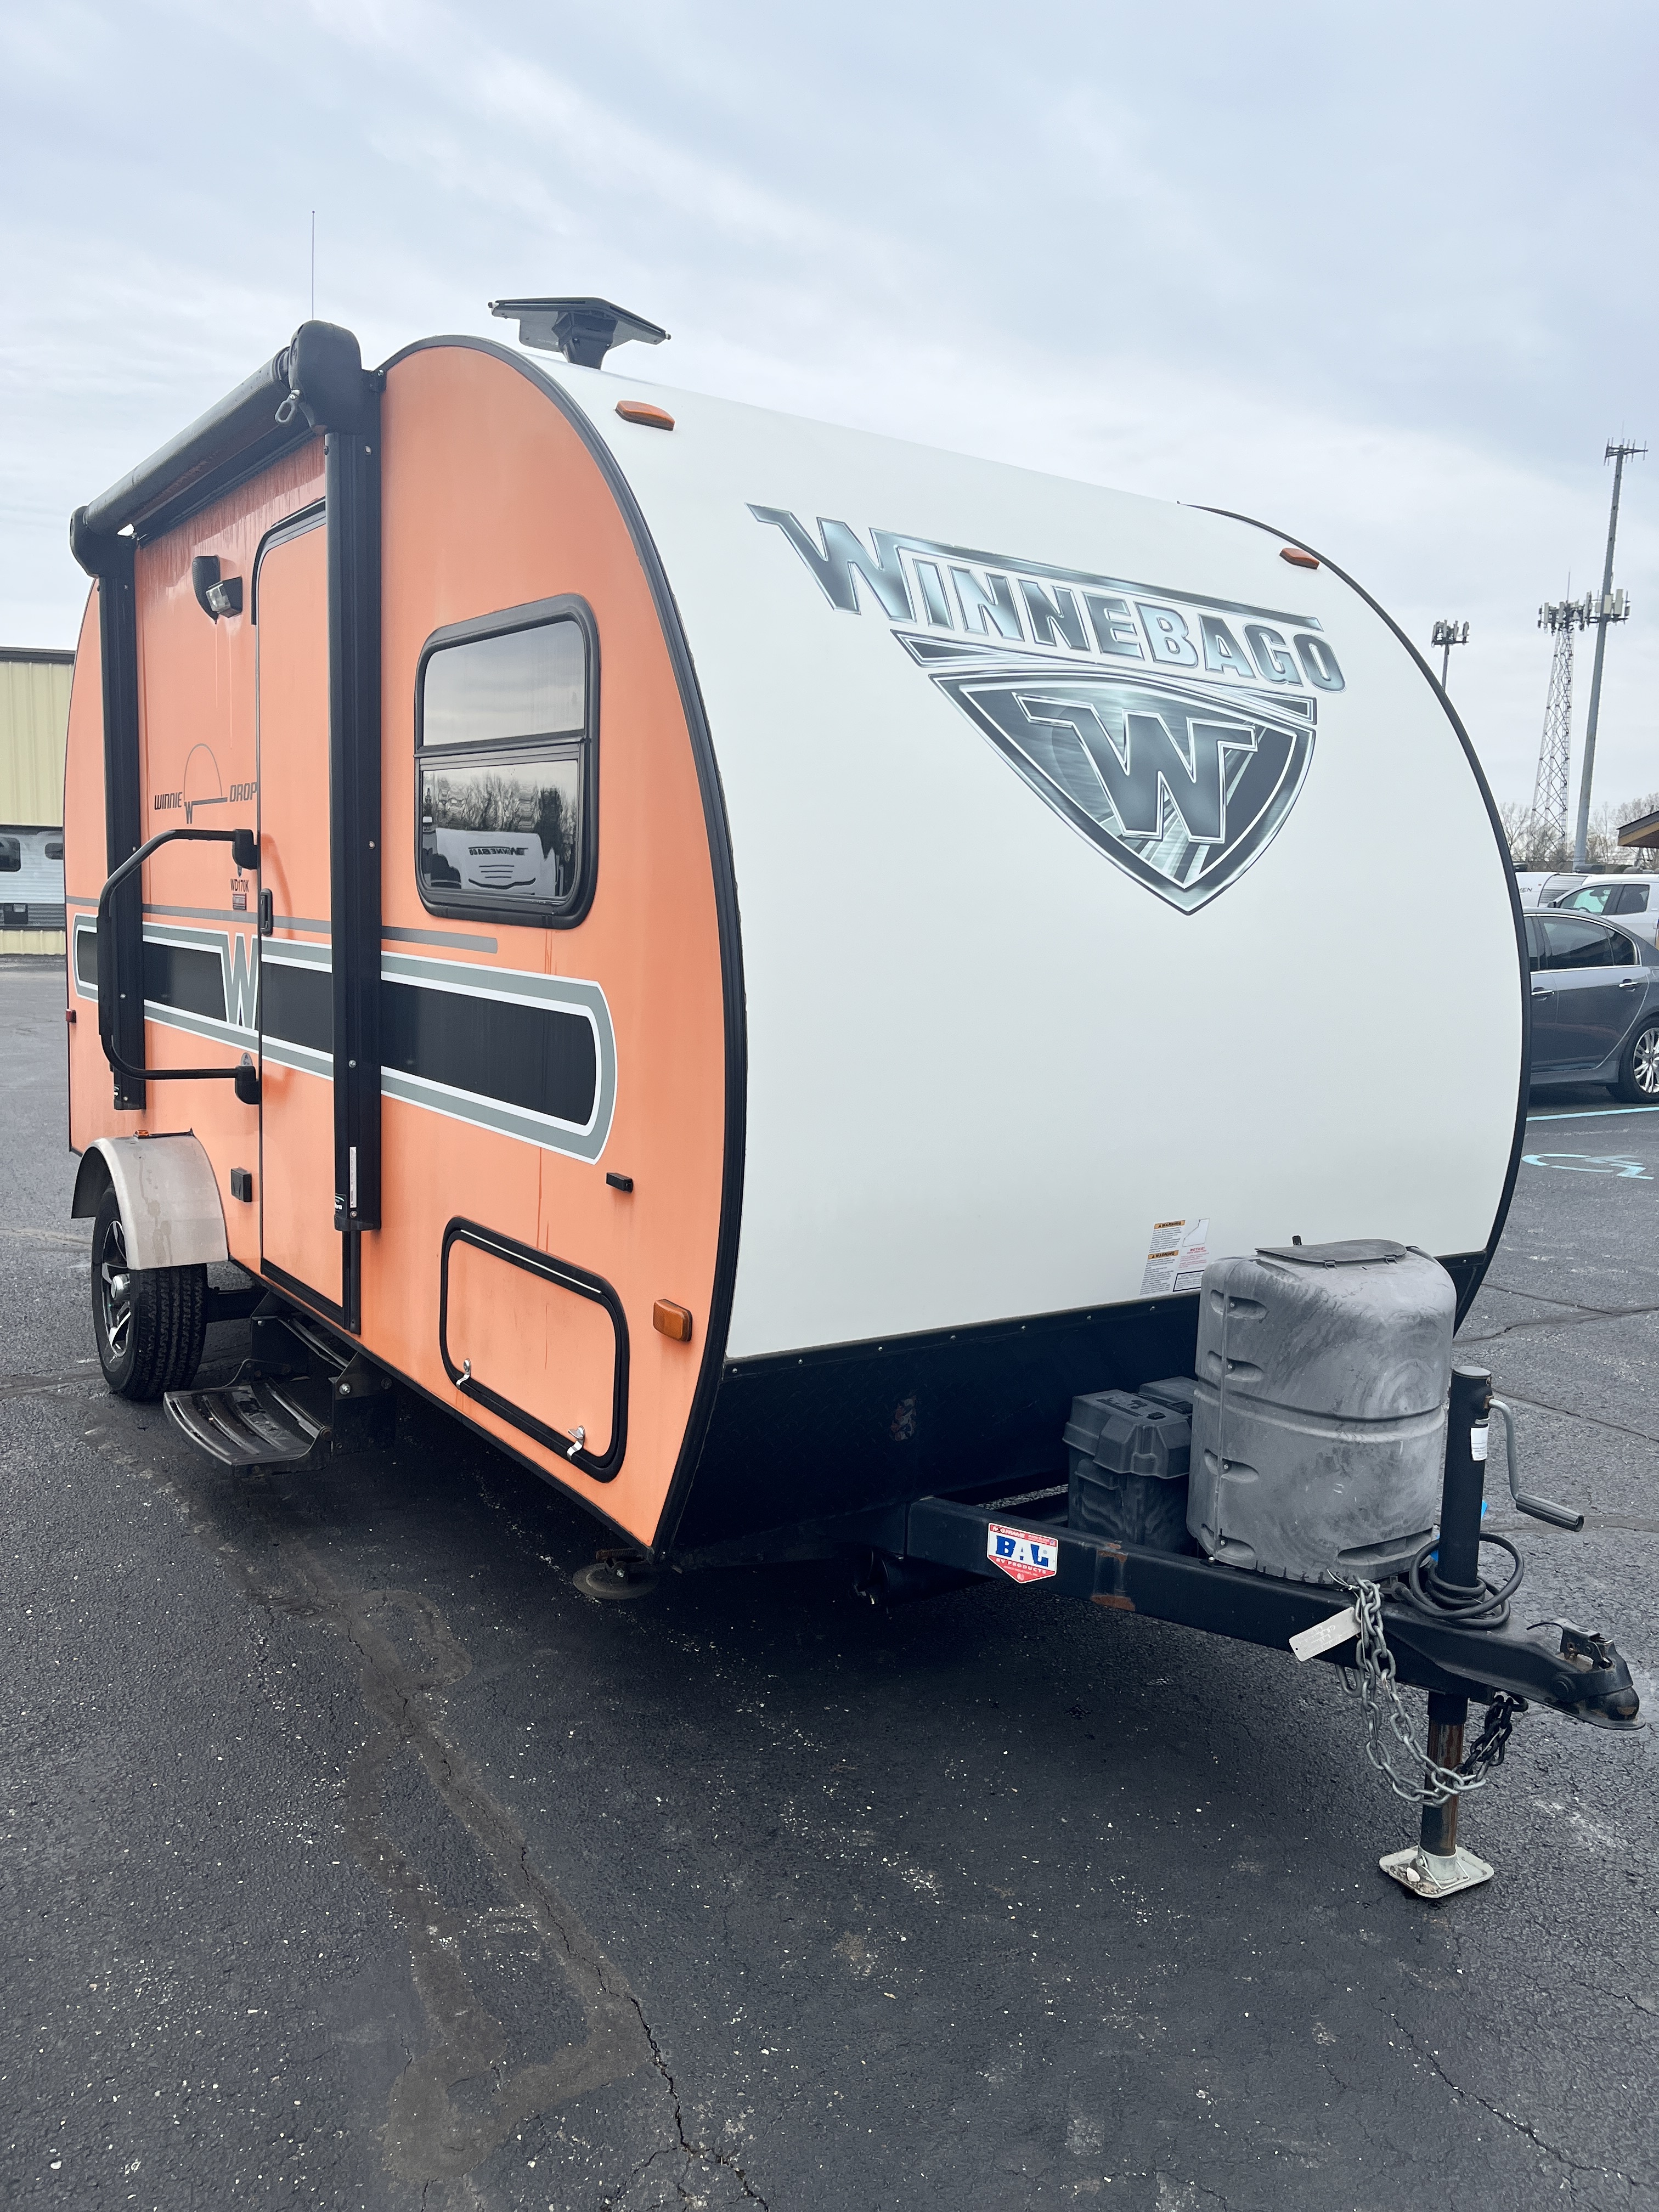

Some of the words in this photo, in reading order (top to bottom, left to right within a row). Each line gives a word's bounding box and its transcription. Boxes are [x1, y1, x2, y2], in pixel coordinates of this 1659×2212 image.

[745, 502, 1347, 693] WINNEBAGO
[1012, 691, 1259, 844] W
[154, 792, 183, 810] WINNIE
[229, 782, 257, 802] DROP
[996, 1535, 1049, 1567] BAL
[1007, 1561, 1046, 1575] PRODUCTS
